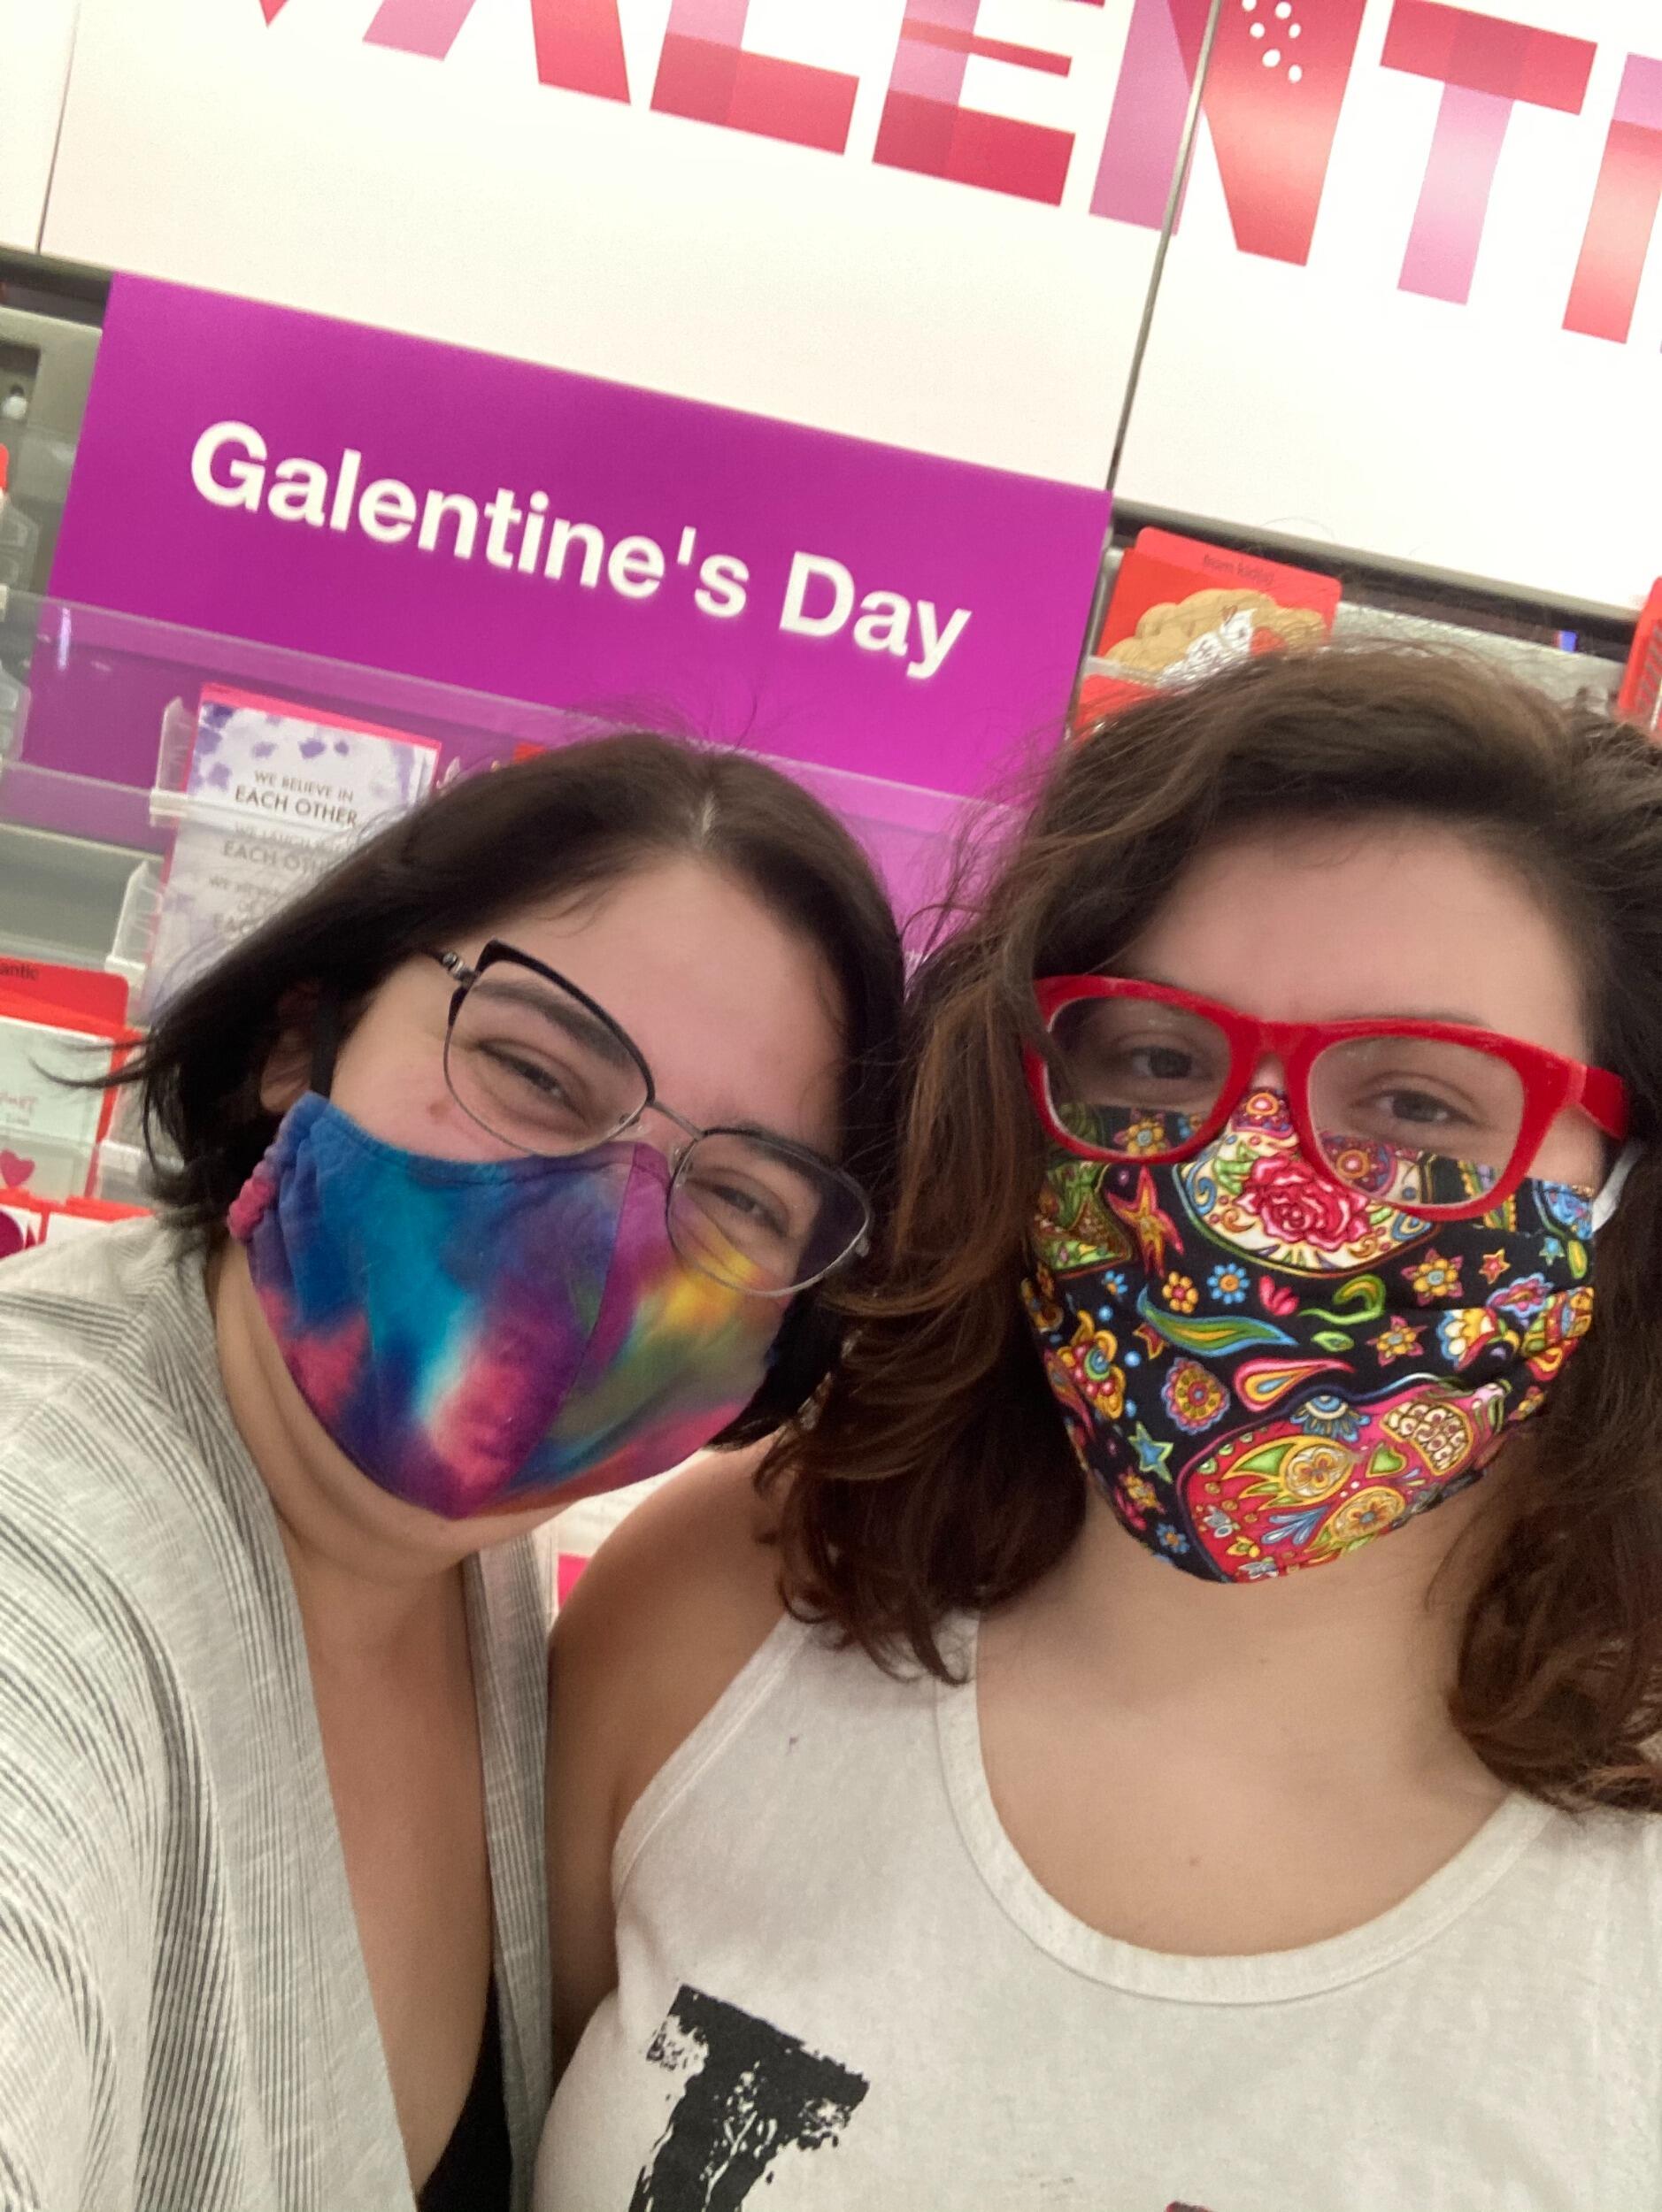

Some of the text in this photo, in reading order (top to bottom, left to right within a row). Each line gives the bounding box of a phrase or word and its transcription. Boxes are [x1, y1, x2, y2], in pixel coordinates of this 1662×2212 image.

[190, 419, 972, 680] Galentine's Day
[254, 770, 354, 803] WE BELIEVE IN
[235, 785, 358, 827] EACH OTHER
[223, 840, 277, 865] EACH
